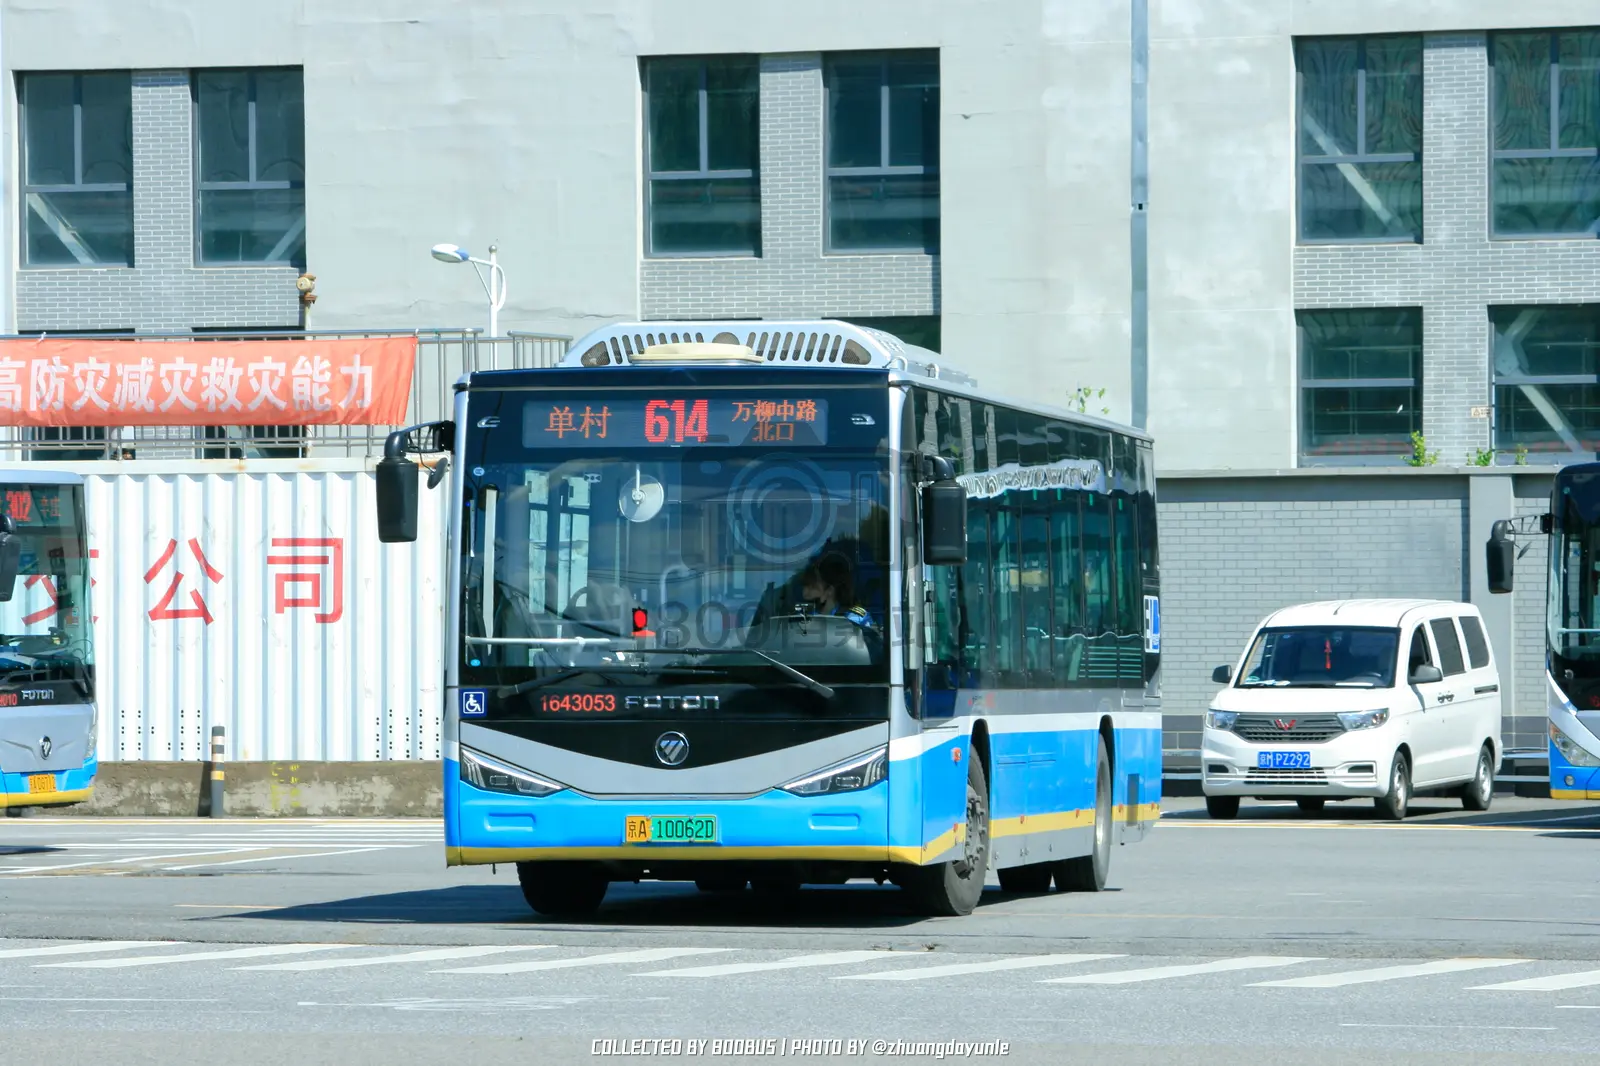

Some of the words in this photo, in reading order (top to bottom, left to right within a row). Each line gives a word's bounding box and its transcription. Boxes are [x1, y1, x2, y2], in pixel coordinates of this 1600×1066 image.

[0, 354, 373, 412] 高防灾减灾救灾能力
[545, 405, 612, 438] 单村
[645, 400, 708, 442] 614
[732, 399, 818, 422] 万柳中路
[752, 422, 795, 442] 北口
[540, 694, 616, 711] 1643053
[624, 695, 720, 709] FOTON
